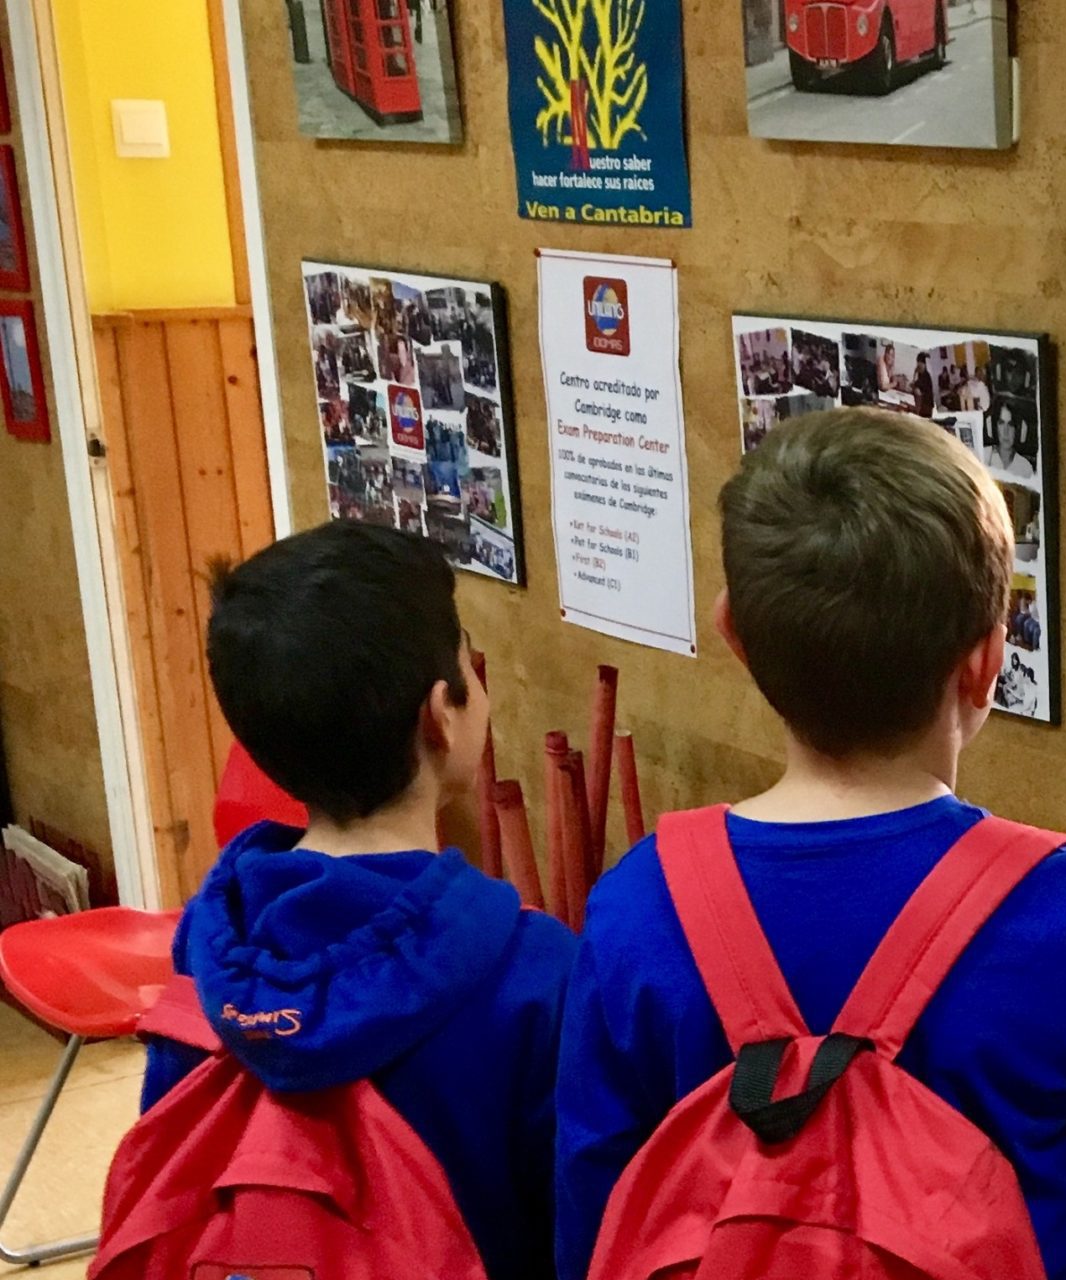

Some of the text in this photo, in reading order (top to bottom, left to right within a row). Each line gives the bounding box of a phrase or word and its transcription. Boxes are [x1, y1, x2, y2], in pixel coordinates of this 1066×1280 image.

[623, 154, 652, 171] saber
[532, 171, 557, 188] hacer
[560, 171, 602, 189] fortalece
[605, 177, 622, 190] sus
[526, 201, 684, 226] Ven a Cantabria
[560, 371, 660, 403] Centro acreditado por
[575, 399, 647, 424] Cambridge como
[557, 419, 670, 454] Exam Preparation Center
[577, 453, 586, 464] de
[588, 456, 622, 472] aprobados
[625, 464, 633, 473] en
[635, 464, 645, 476] las
[564, 471, 668, 500] convocatorias de los siguientes
[608, 496, 617, 507] de
[599, 542, 622, 557] Schools
